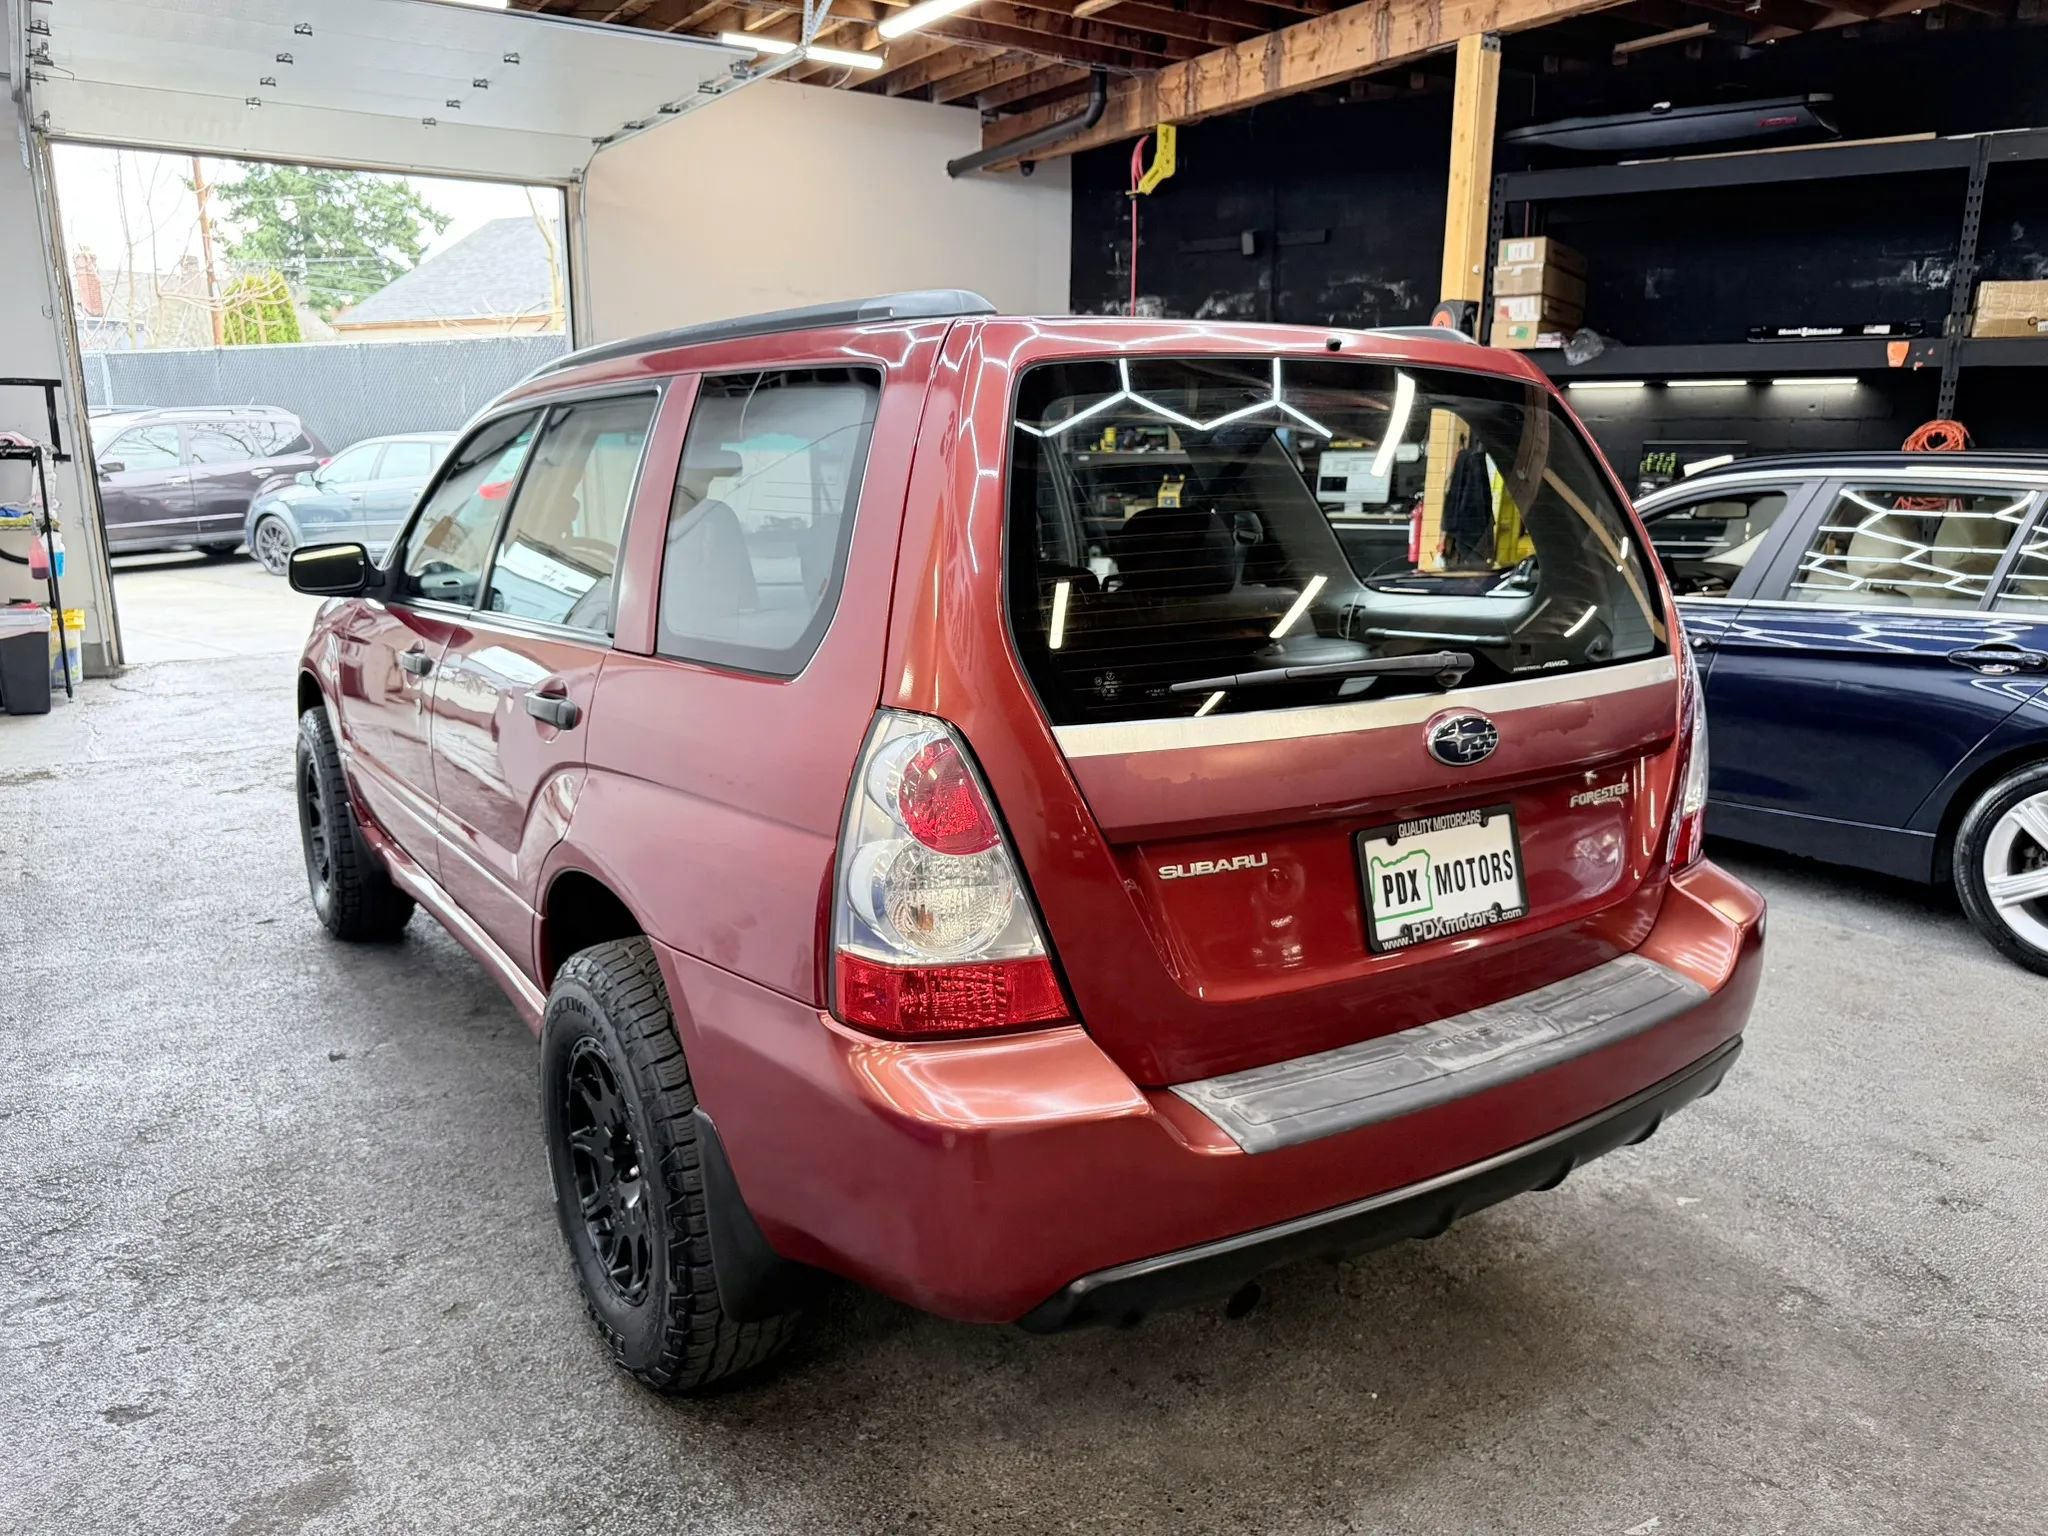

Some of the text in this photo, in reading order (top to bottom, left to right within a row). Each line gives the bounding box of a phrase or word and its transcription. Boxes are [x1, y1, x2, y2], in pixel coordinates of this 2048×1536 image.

[1569, 782, 1629, 808] FORESTER
[1398, 809, 1482, 838] QUALITY MOTORCARS
[1158, 852, 1268, 879] SUBARU
[1382, 849, 1513, 908] PDX MOTORS
[1382, 908, 1523, 951] www.PDXmotors.com
